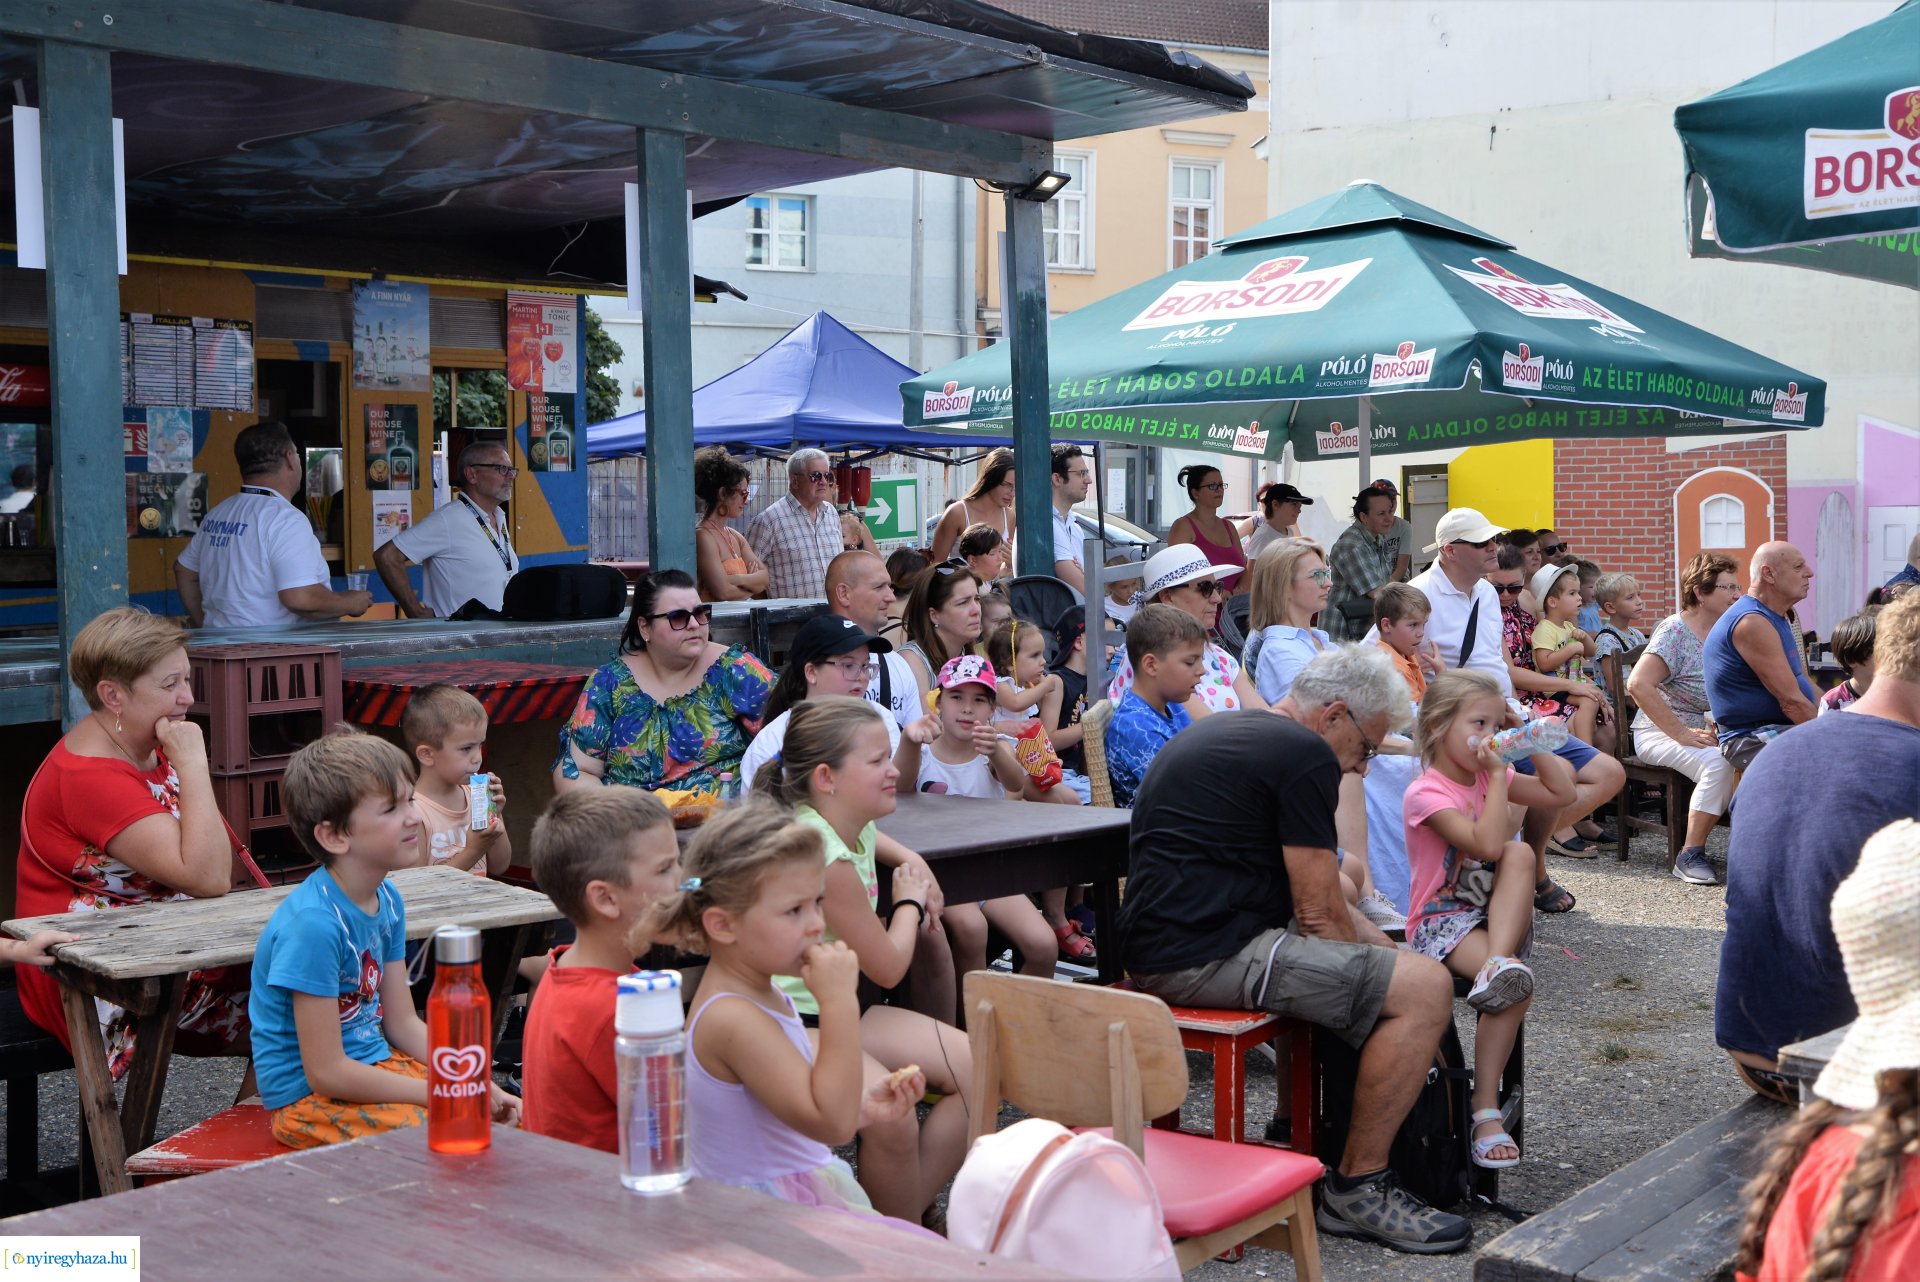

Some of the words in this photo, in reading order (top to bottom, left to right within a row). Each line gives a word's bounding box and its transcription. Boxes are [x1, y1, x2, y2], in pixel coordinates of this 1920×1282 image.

[1144, 277, 1344, 320] BORSODI
[512, 306, 538, 314] MARTINI
[155, 317, 191, 326] ITALLAP
[548, 313, 570, 322] TONIC
[216, 321, 249, 330] ITALLAP
[535, 324, 549, 335] 1+1
[1161, 322, 1237, 342] PÓLÓ
[1320, 354, 1367, 376] PÓLÓ
[1372, 359, 1430, 380] BORSODI
[1315, 378, 1368, 388] ALKOHOLMENTES
[1504, 363, 1542, 383] BORSODI
[1545, 358, 1574, 380] PÓLÓ
[1582, 366, 1602, 389] AZ
[1607, 363, 1643, 391] ÉLET
[1647, 372, 1693, 399] HABOS
[1696, 381, 1744, 408] OLDALA
[1751, 386, 1775, 406] PÓLÓ
[1774, 398, 1804, 415] BORSODI
[925, 396, 970, 413] BORSODI
[1057, 377, 1110, 399] ÉLET
[1115, 371, 1198, 394] HABOS
[1205, 364, 1305, 388] OLDALA
[531, 396, 549, 404] OUR
[532, 405, 560, 413] HOUSE
[370, 410, 390, 418] OUR
[532, 415, 554, 423] WINE
[370, 420, 402, 428] HOUSE
[533, 424, 541, 432] IS
[370, 430, 395, 438] WINE
[372, 440, 381, 448] IS
[139, 474, 163, 483] LIFE
[139, 485, 180, 494] BEGINS
[139, 495, 154, 505] AT
[433, 1081, 487, 1098] ALGIDA
